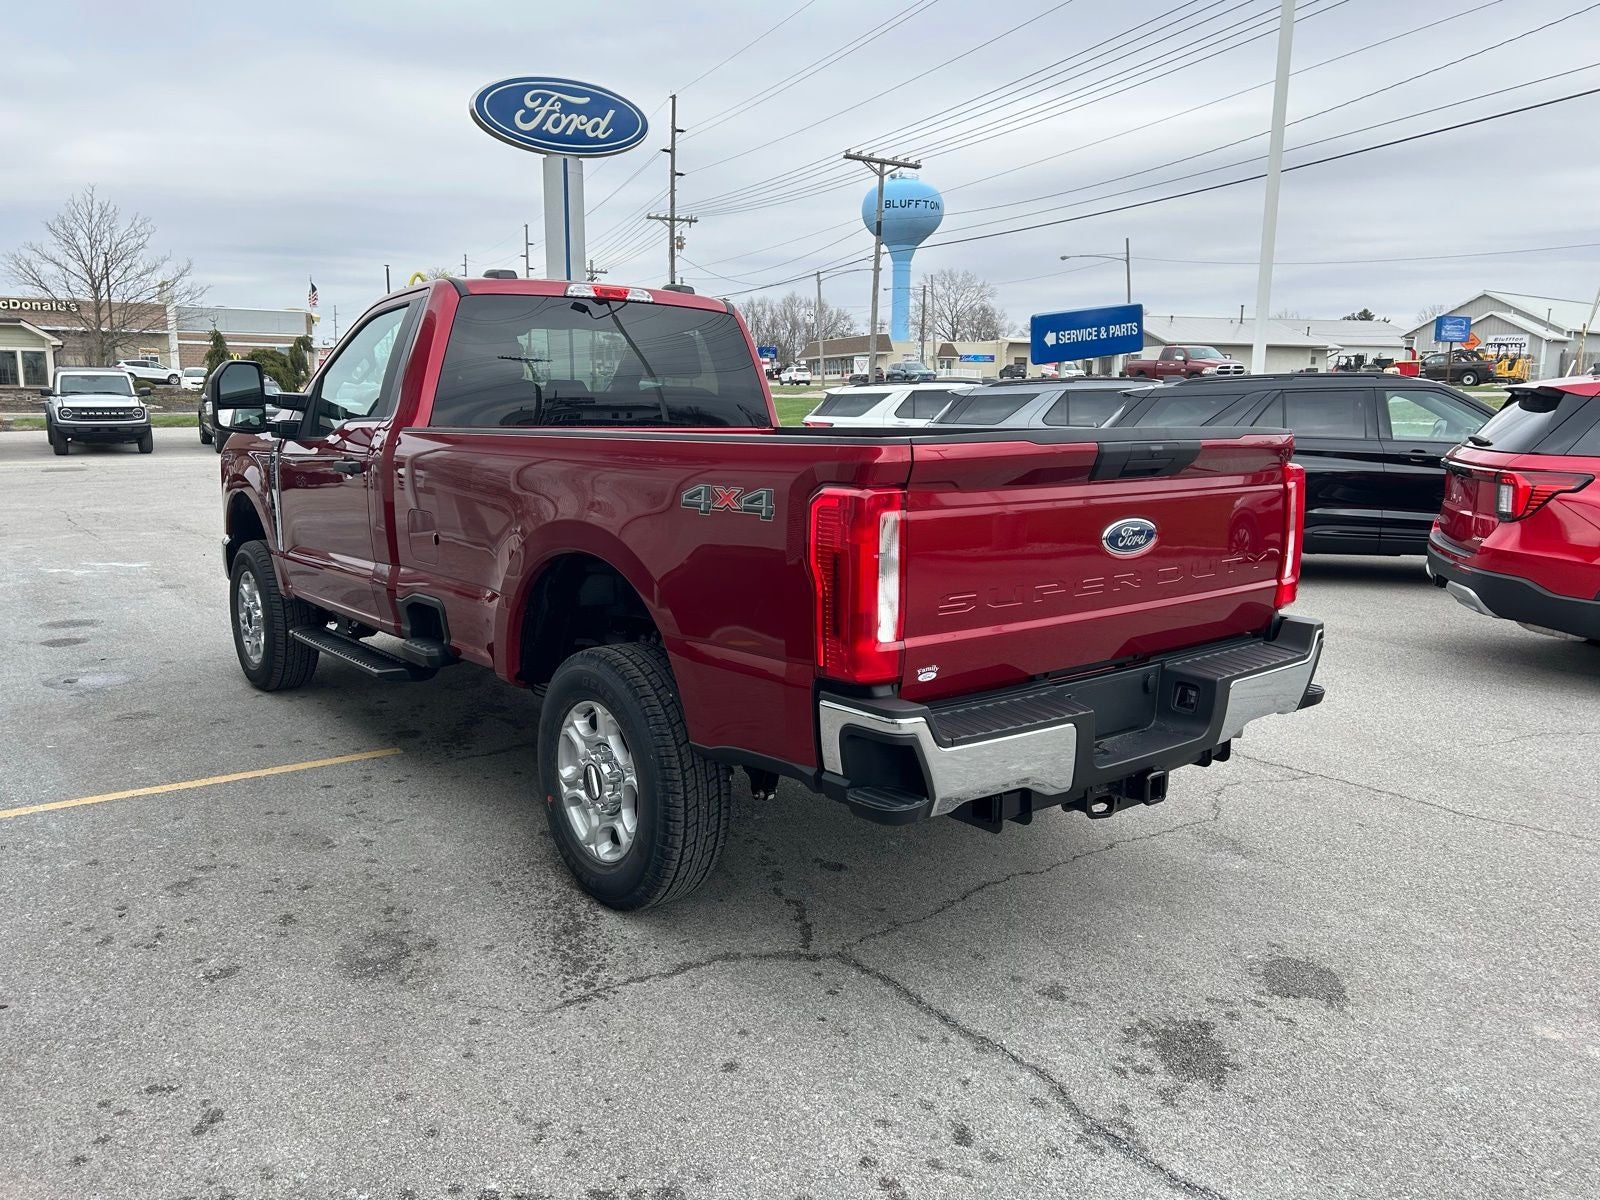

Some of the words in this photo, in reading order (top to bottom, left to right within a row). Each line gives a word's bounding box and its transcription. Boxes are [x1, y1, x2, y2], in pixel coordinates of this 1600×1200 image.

[514, 89, 615, 139] Ford
[884, 199, 940, 211] BLUFFTON
[0, 299, 78, 312] cDonald's
[1058, 327, 1098, 344] SERVICE
[1100, 326, 1107, 339] &
[1109, 322, 1138, 338] PARTS
[1118, 526, 1147, 547] Ford
[938, 573, 1142, 616] SUPER
[1154, 552, 1272, 585] DUTY
[917, 664, 939, 675] Family
